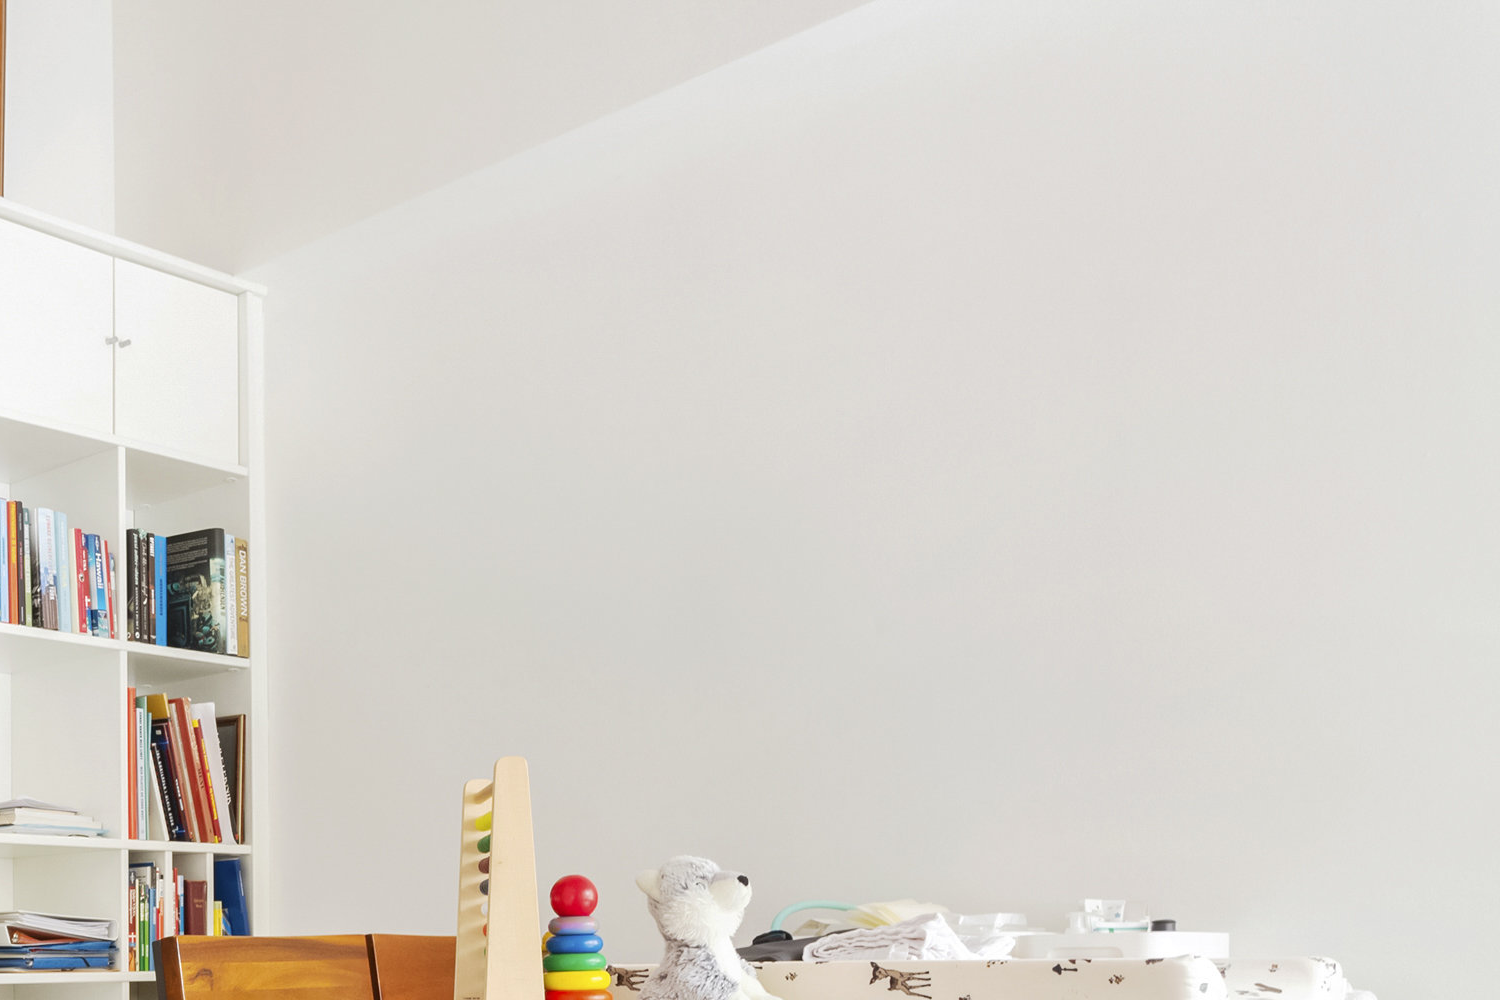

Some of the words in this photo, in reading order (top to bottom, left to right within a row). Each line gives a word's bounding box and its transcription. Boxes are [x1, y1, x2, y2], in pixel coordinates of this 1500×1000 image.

[95, 553, 104, 589] Hawaii
[239, 550, 247, 574] DAN
[239, 575, 248, 616] BROWN
